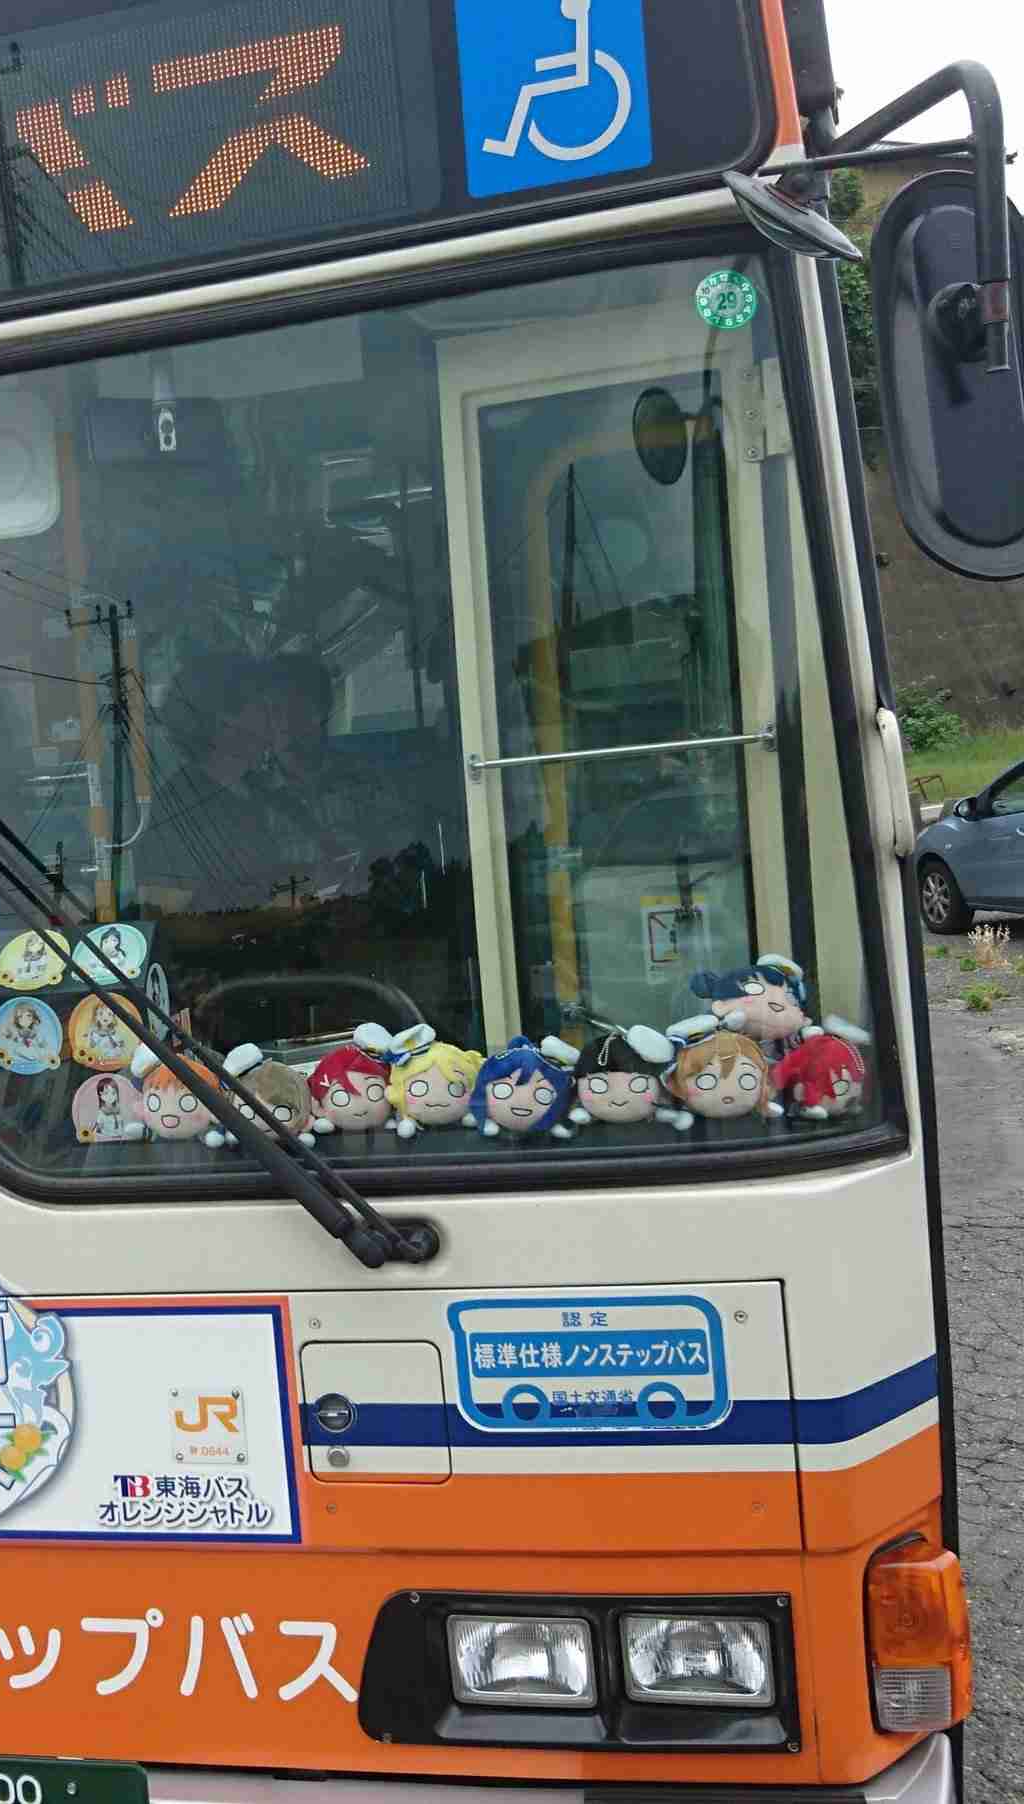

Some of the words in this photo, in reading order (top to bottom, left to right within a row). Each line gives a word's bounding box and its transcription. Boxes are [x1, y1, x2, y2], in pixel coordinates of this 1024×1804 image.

[717, 291, 737, 309] 29
[561, 1311, 609, 1328] 認定
[474, 1339, 706, 1370] 標準仕様ノンステップバス
[174, 1396, 239, 1432] JR
[154, 1474, 248, 1499] 東海バス
[98, 1501, 268, 1525] オレンジシャトル
